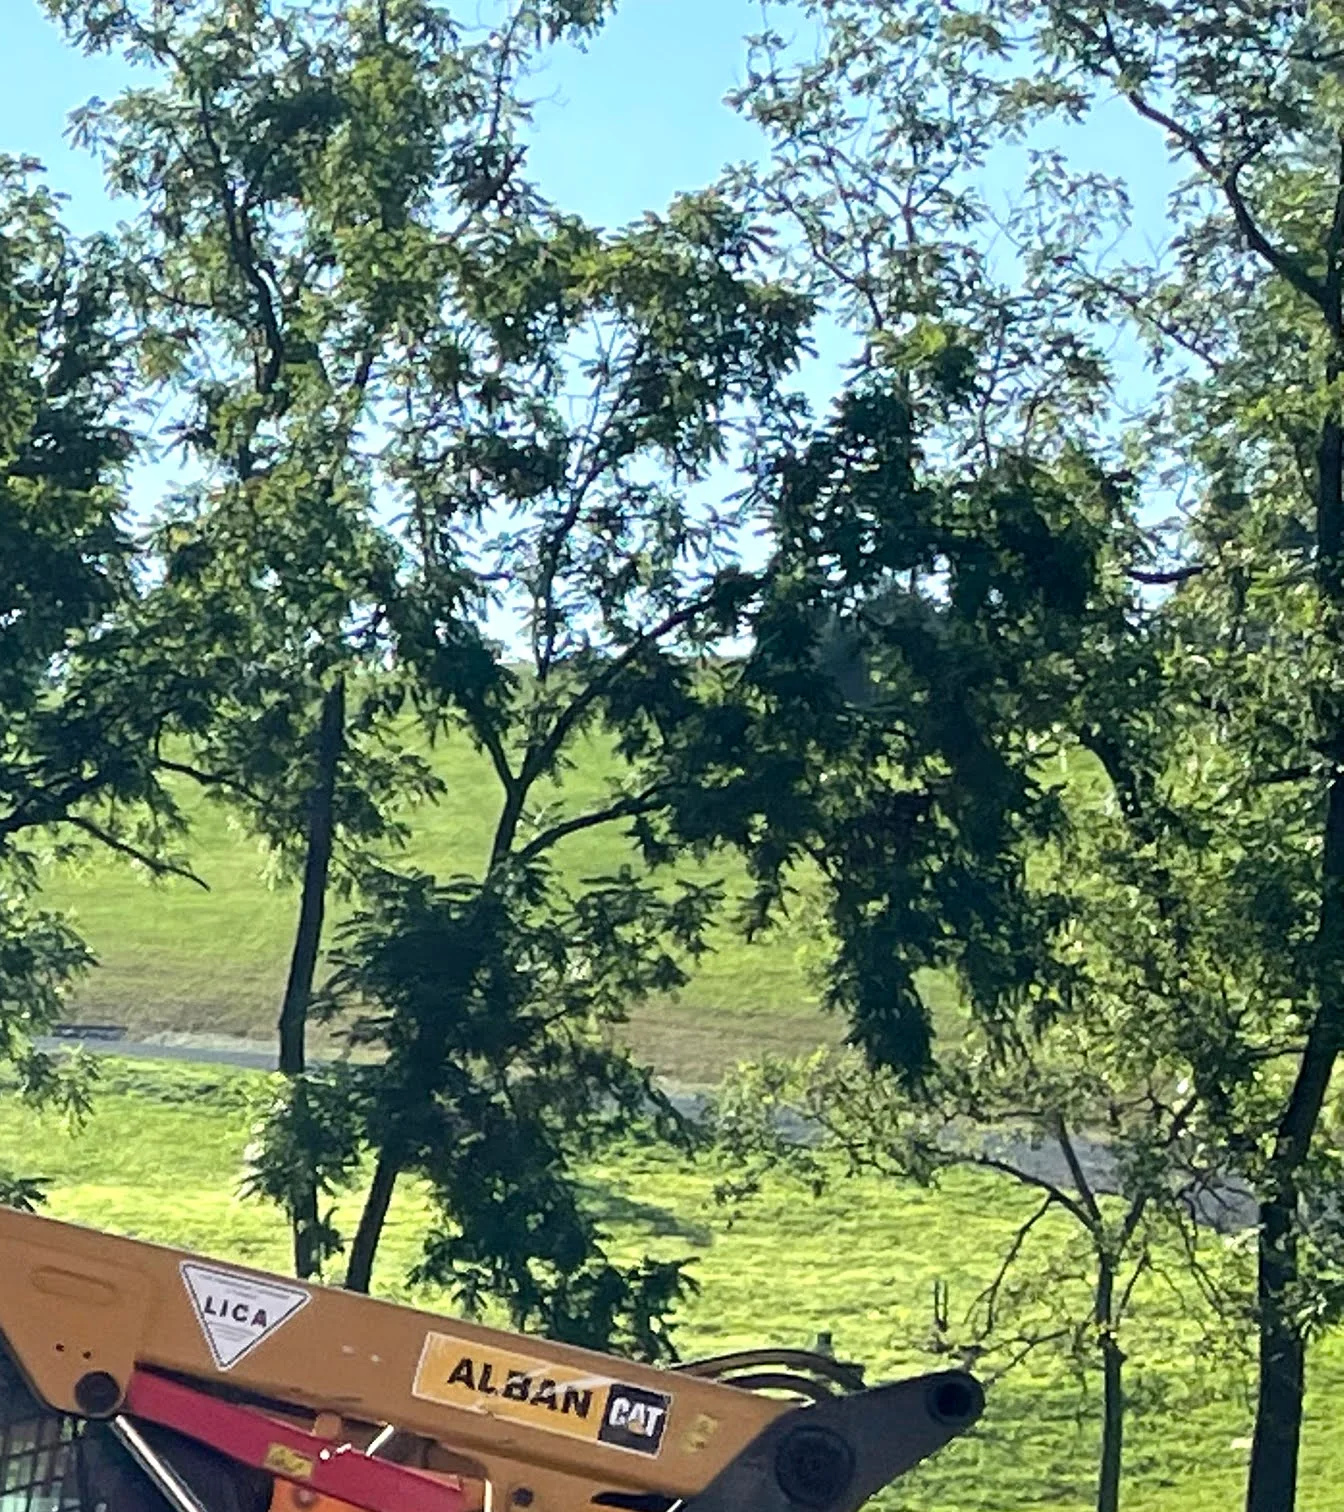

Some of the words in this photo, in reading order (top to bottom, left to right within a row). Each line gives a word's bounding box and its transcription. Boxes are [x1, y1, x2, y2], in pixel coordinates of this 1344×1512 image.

[204, 1296, 267, 1328] LICA
[447, 1358, 593, 1419] ALBAN
[609, 1398, 664, 1438] CAT
